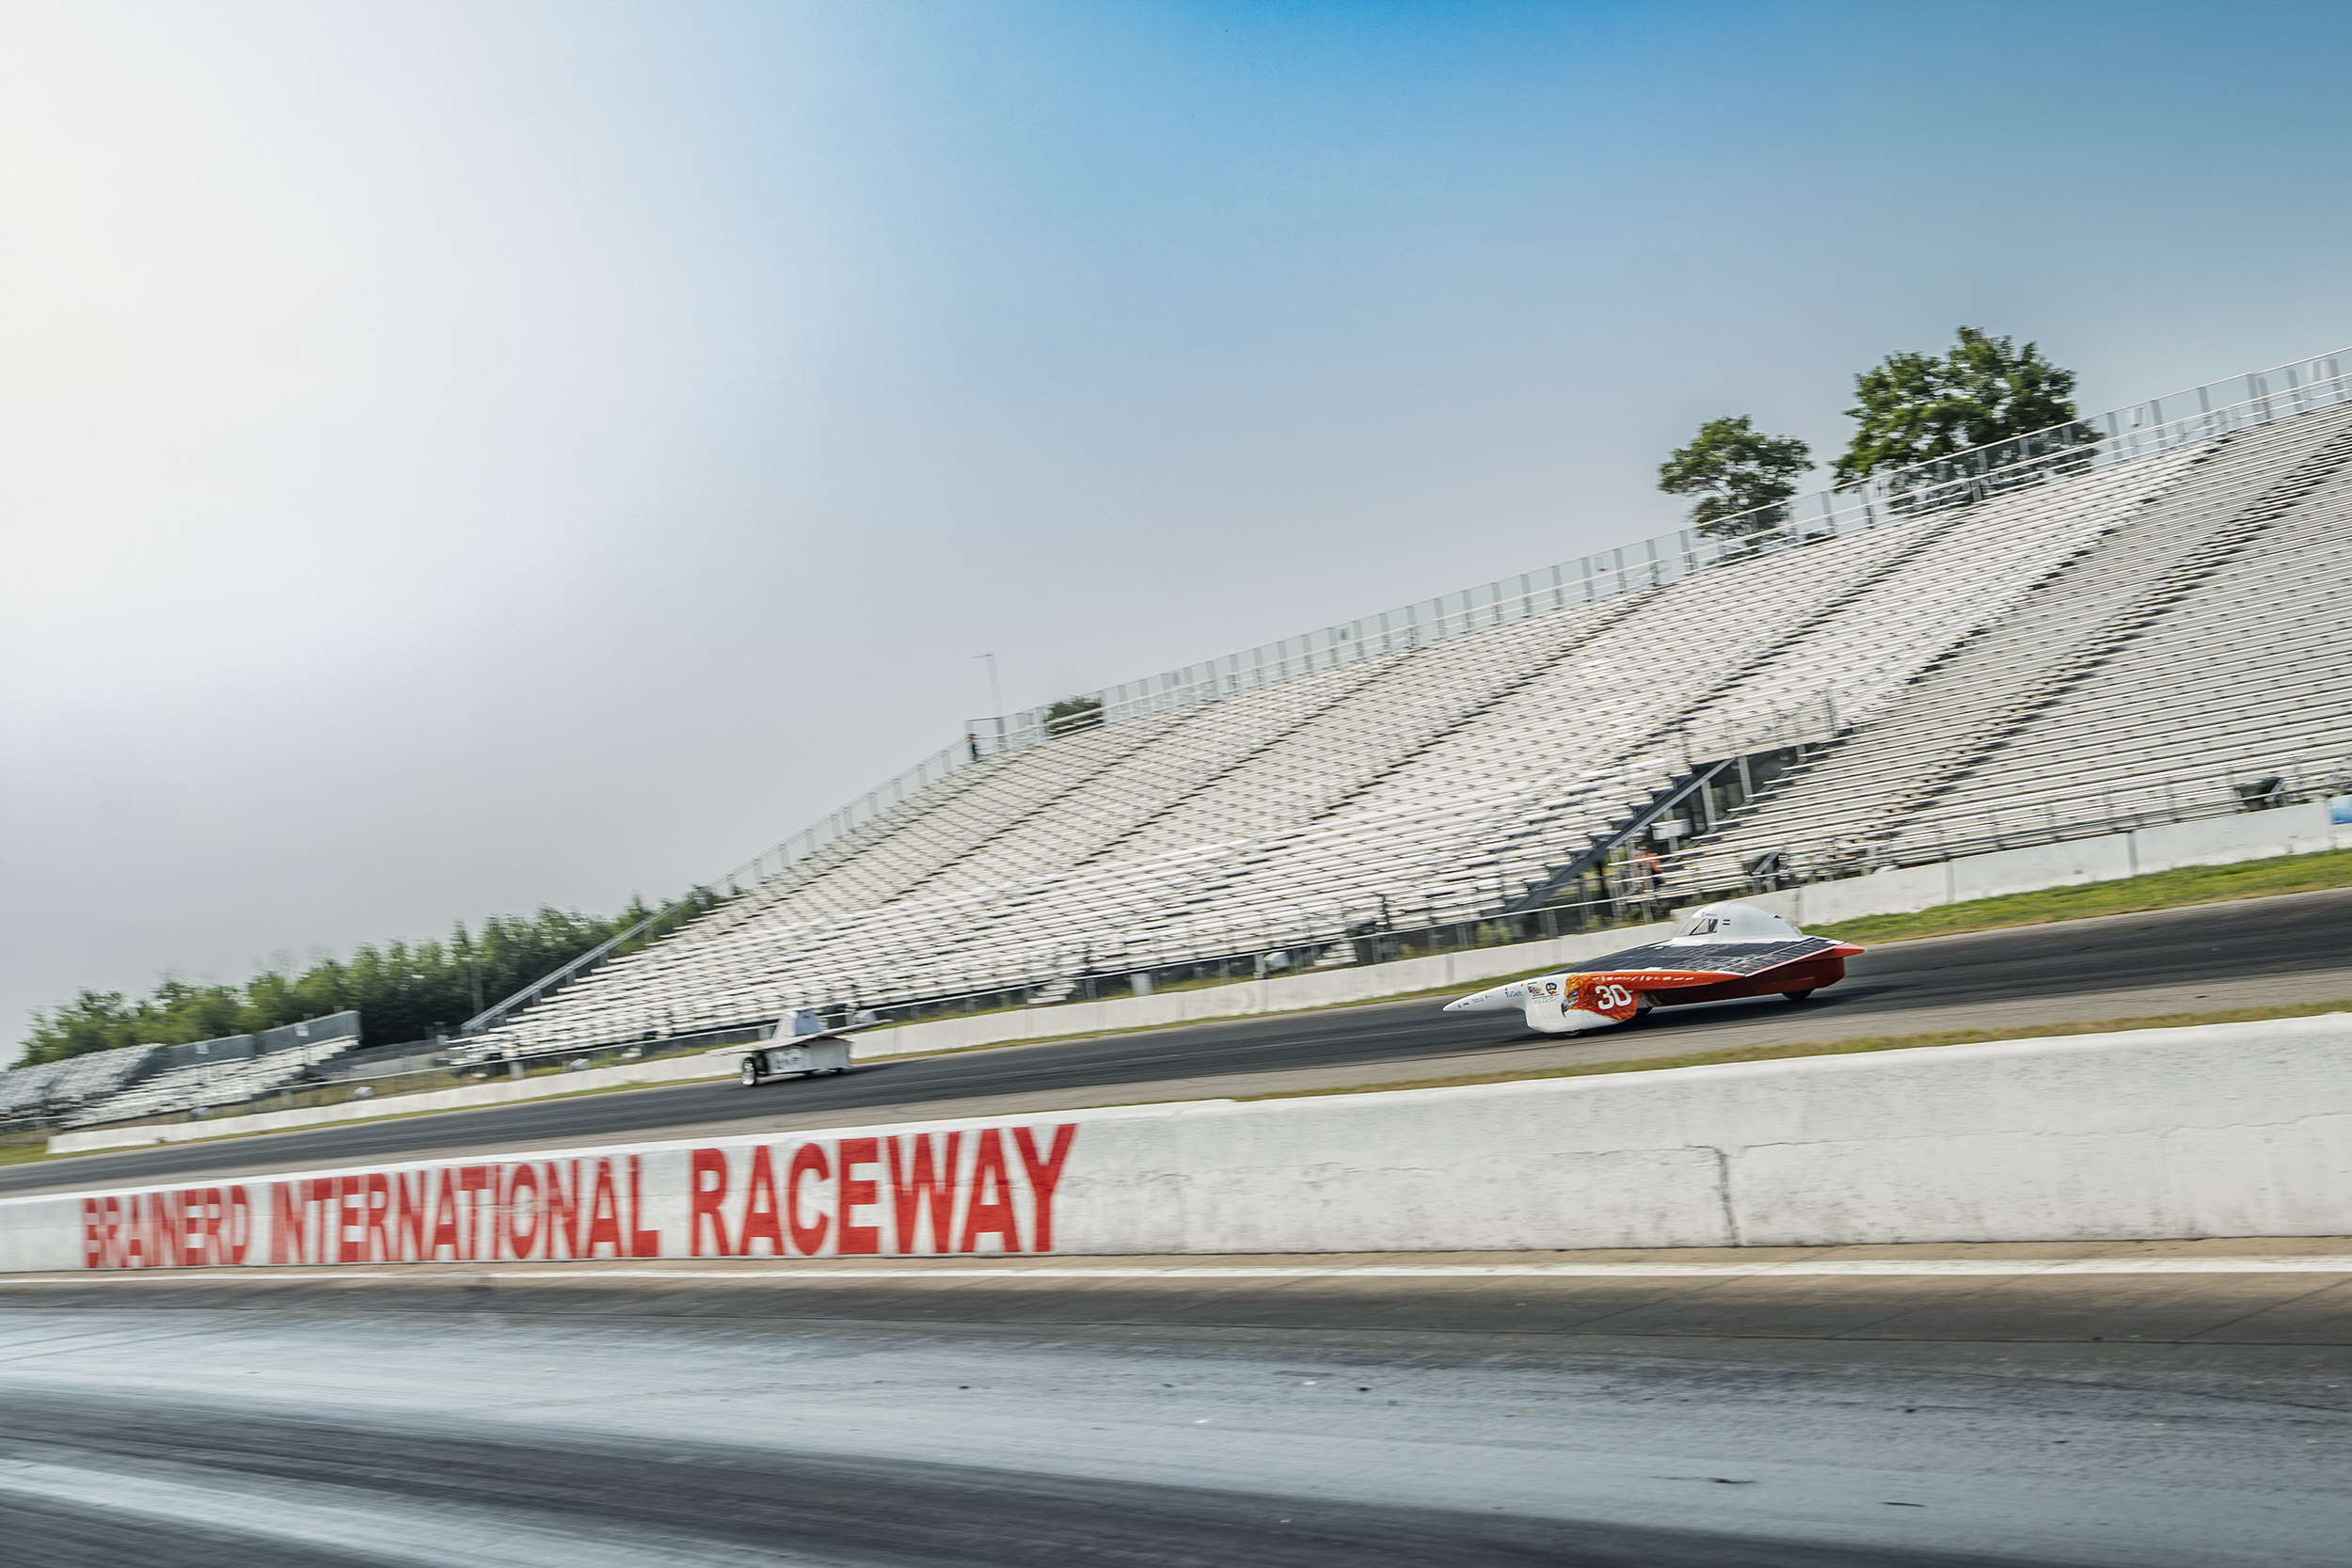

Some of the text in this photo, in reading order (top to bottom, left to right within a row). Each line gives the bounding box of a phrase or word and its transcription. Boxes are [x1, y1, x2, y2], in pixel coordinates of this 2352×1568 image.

[1595, 984, 1632, 1010] 30
[83, 1123, 1079, 1268] BRAINERD INTERNATIONAL RACEWAY
